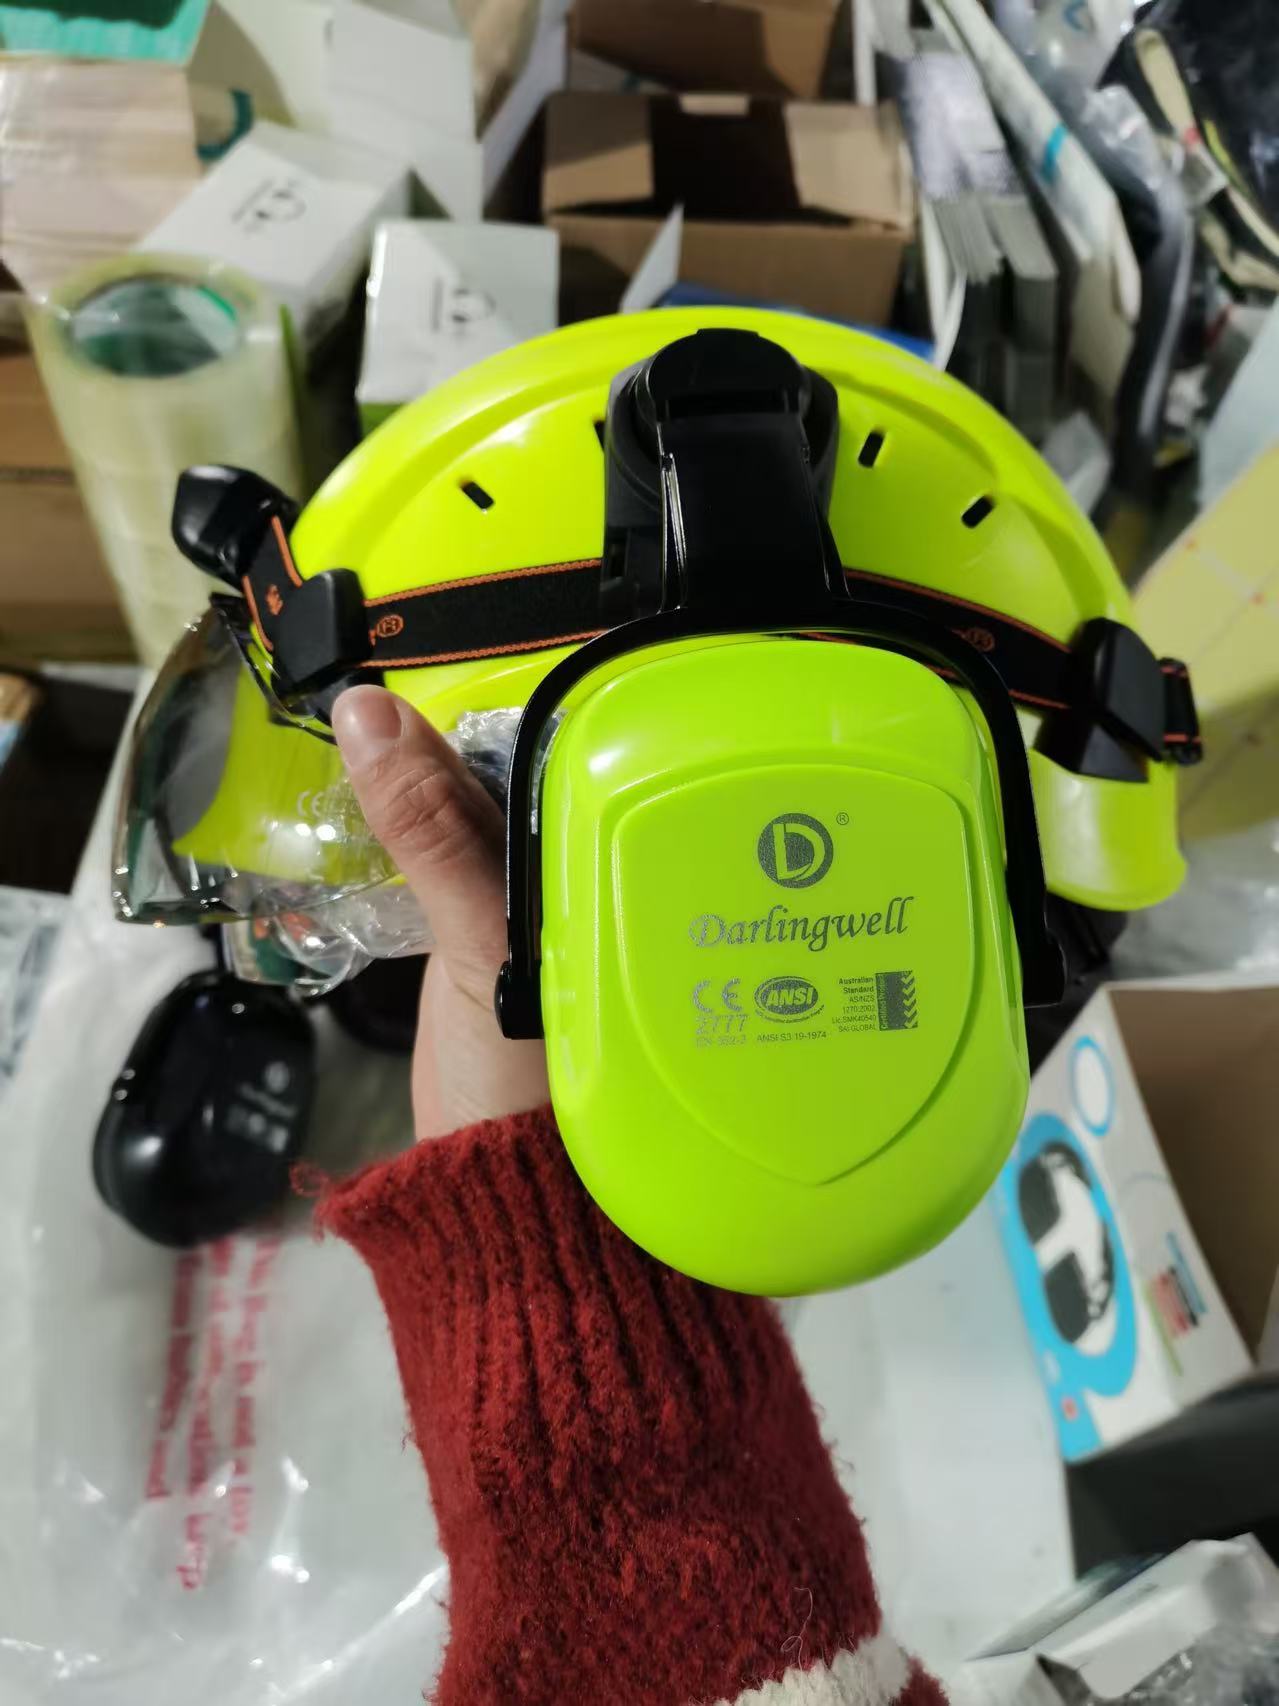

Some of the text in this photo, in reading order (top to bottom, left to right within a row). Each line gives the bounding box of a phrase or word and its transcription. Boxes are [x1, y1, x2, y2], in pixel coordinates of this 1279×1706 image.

[689, 896, 915, 952] Darlingwell
[839, 976, 874, 985] Australian
[843, 985, 874, 994] Standard
[693, 978, 743, 1014] CE
[766, 988, 814, 1006] ANSI
[695, 1014, 748, 1034] 2777
